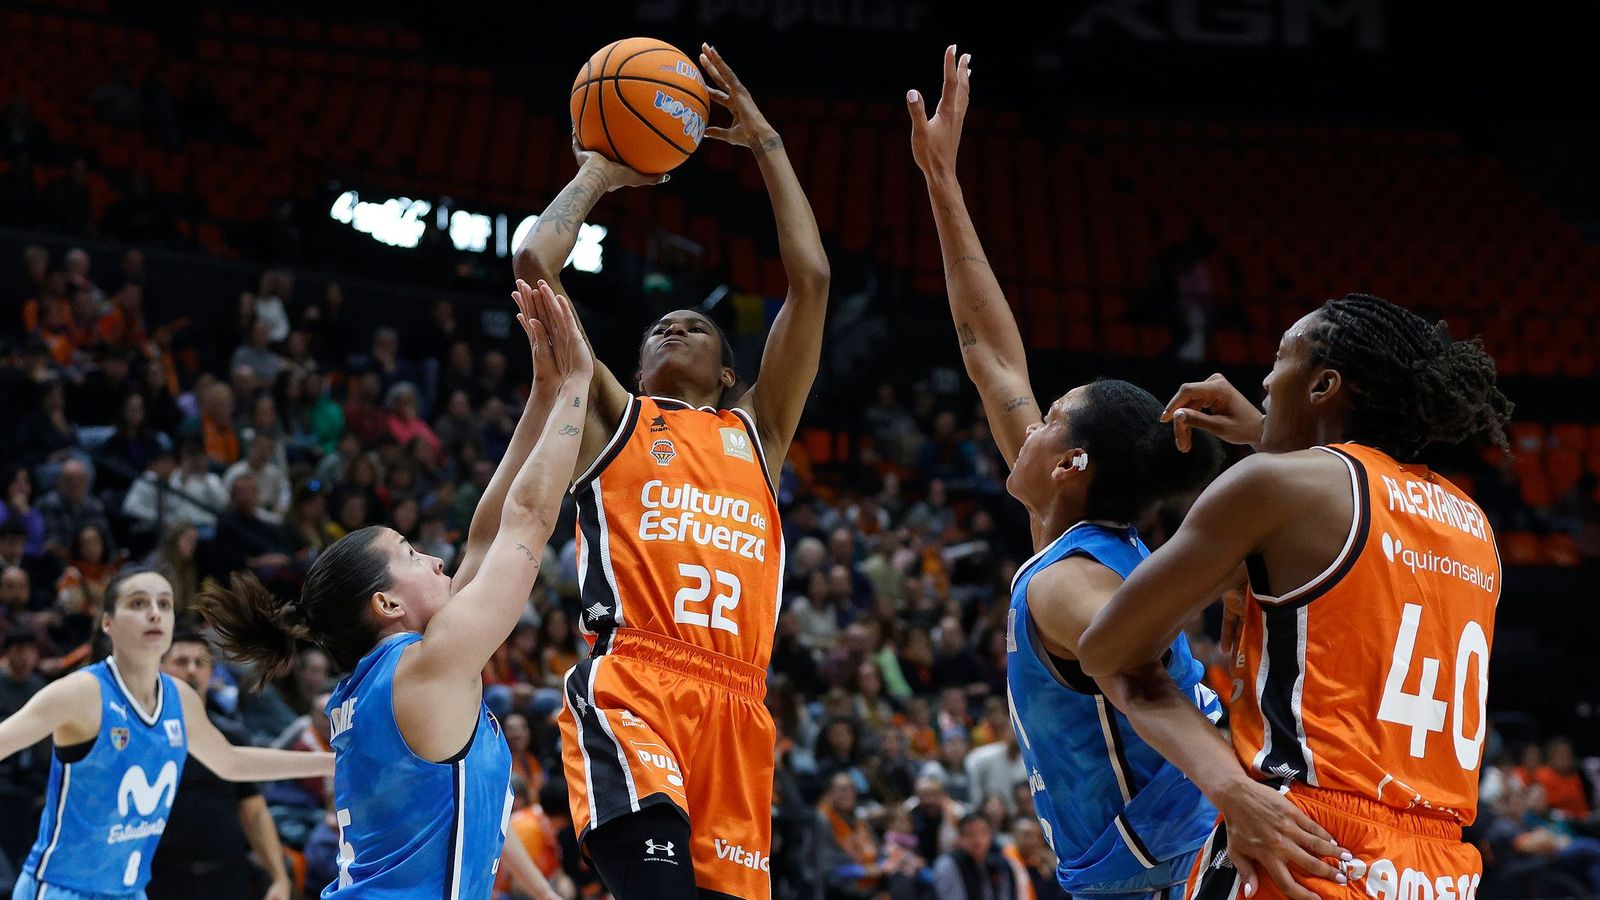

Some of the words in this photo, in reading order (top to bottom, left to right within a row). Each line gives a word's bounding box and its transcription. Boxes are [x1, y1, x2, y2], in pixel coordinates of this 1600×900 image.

[641, 480, 750, 523] Cultura
[1381, 474, 1487, 542] ALEXANDER
[674, 562, 741, 636] 22
[1402, 547, 1494, 593] quirónsalud
[1377, 603, 1489, 771] 40
